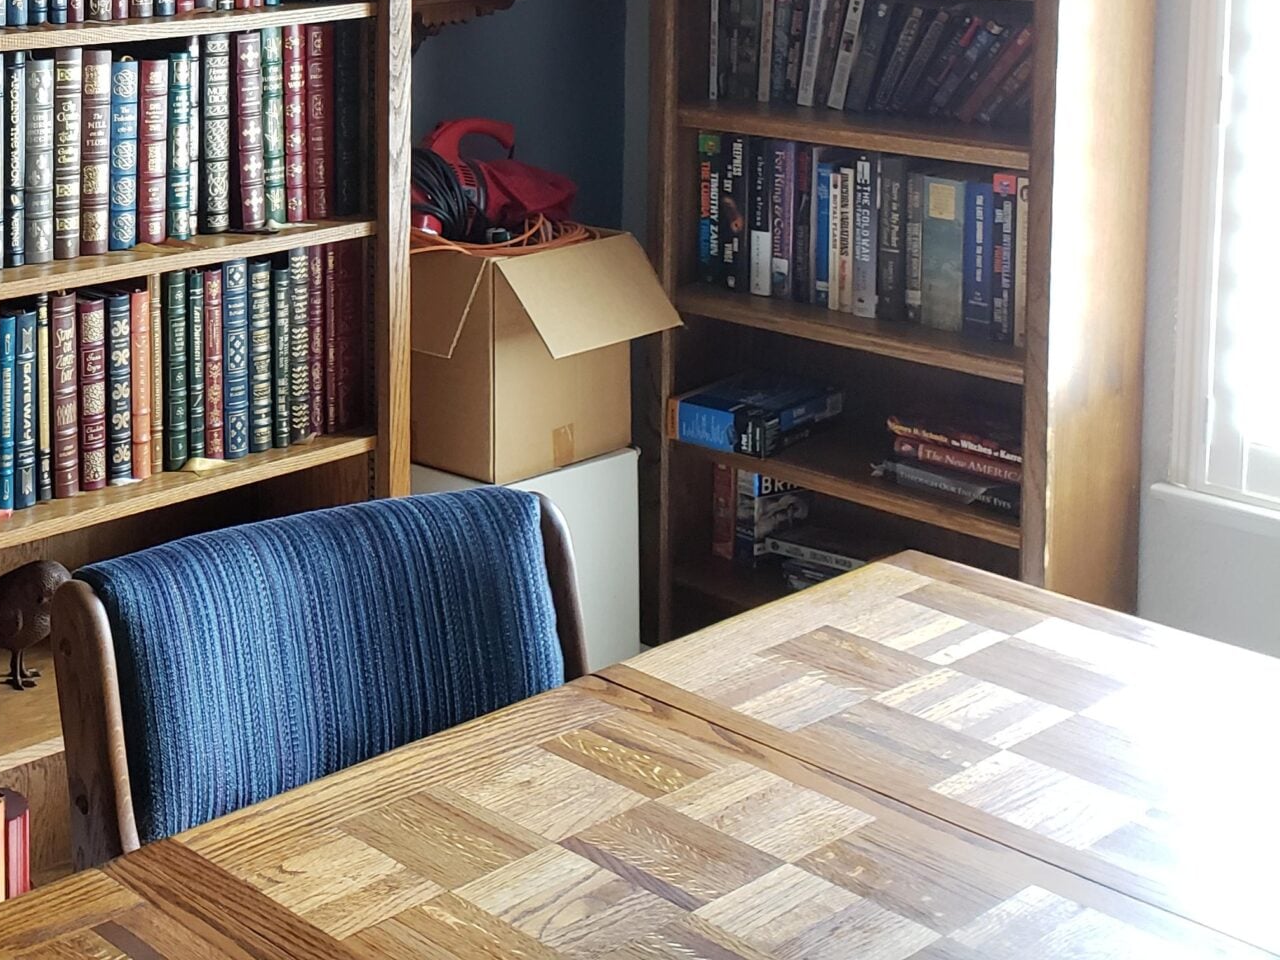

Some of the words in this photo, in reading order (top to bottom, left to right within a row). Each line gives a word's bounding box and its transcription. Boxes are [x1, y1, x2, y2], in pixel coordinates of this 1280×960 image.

[11, 75, 20, 124] AROUND
[11, 151, 20, 187] MOON
[775, 151, 785, 172] For
[710, 173, 718, 222] TIMOTHY
[773, 174, 785, 203] King
[862, 187, 870, 205] THE
[862, 207, 870, 237] COLD
[710, 224, 718, 256] ZAHN
[862, 238, 870, 261] WAR
[23, 363, 33, 440] GATEWAY
[926, 450, 943, 460] The
[945, 456, 967, 467] New
[960, 440, 992, 455] Witches
